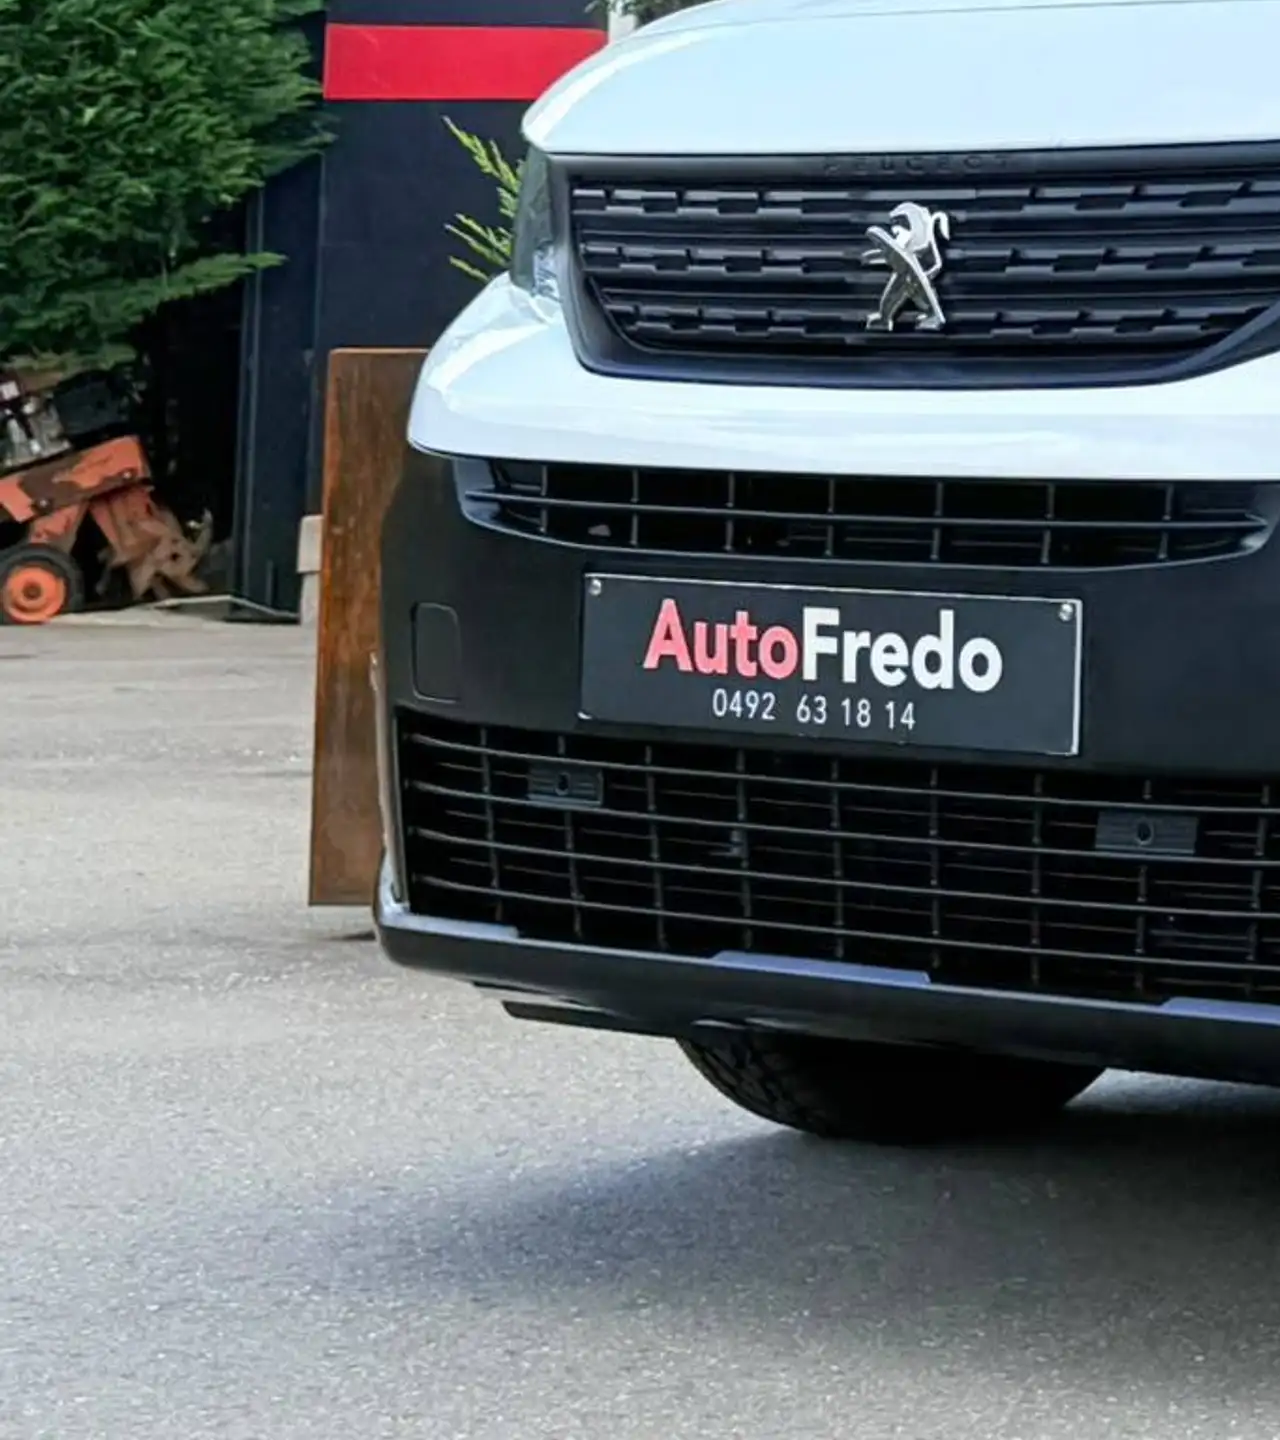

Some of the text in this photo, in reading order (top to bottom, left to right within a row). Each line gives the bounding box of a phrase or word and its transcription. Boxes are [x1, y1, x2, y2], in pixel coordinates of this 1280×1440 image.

[642, 597, 1003, 693] AutoFredo
[712, 687, 916, 731] 0492 63 18 14
